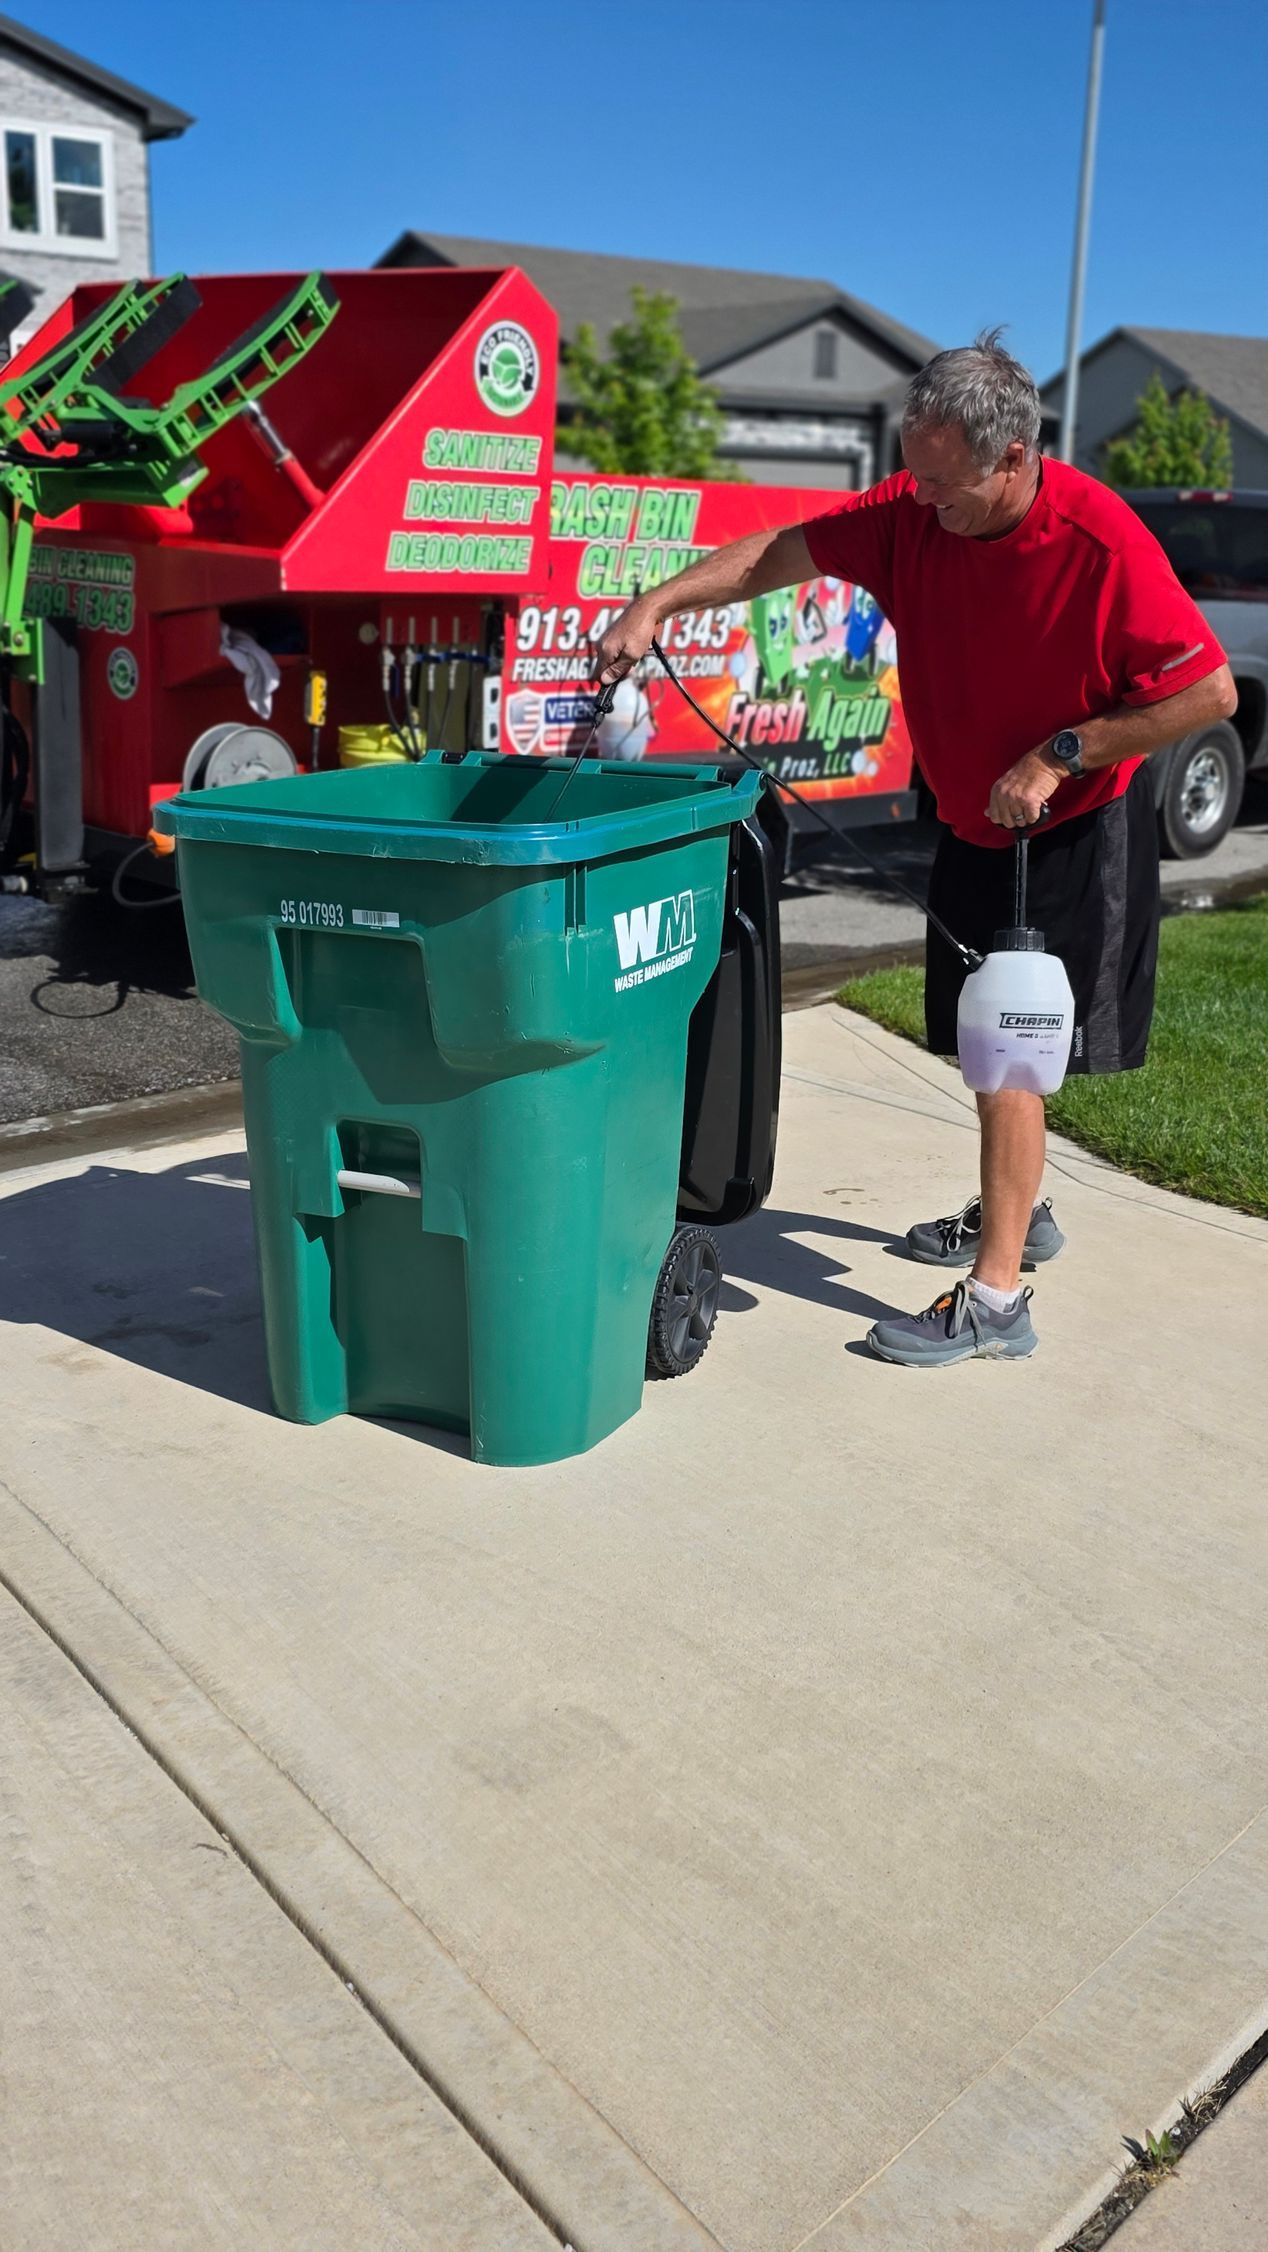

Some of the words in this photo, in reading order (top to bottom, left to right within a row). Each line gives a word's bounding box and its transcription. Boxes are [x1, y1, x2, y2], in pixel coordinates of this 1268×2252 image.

[424, 429, 541, 473] SANITIZE
[404, 480, 540, 524] DISINFECT
[550, 481, 638, 541] RASH
[634, 488, 701, 545] BIN
[57, 549, 133, 586] CLEANING
[386, 532, 533, 574] DEODORIZE
[577, 543, 715, 599] CLEAN
[546, 701, 598, 719] VETER
[725, 688, 807, 745] Fresh
[806, 684, 890, 751] Again
[823, 752, 850, 775] LLC
[280, 899, 296, 923] 95
[299, 901, 344, 928] 017993
[613, 889, 695, 970] WM
[614, 968, 644, 993] WASTE
[644, 946, 694, 982] MANAGEMENT
[1005, 1016, 1060, 1027] CHAPIN
[1074, 1025, 1083, 1057] Reebok
